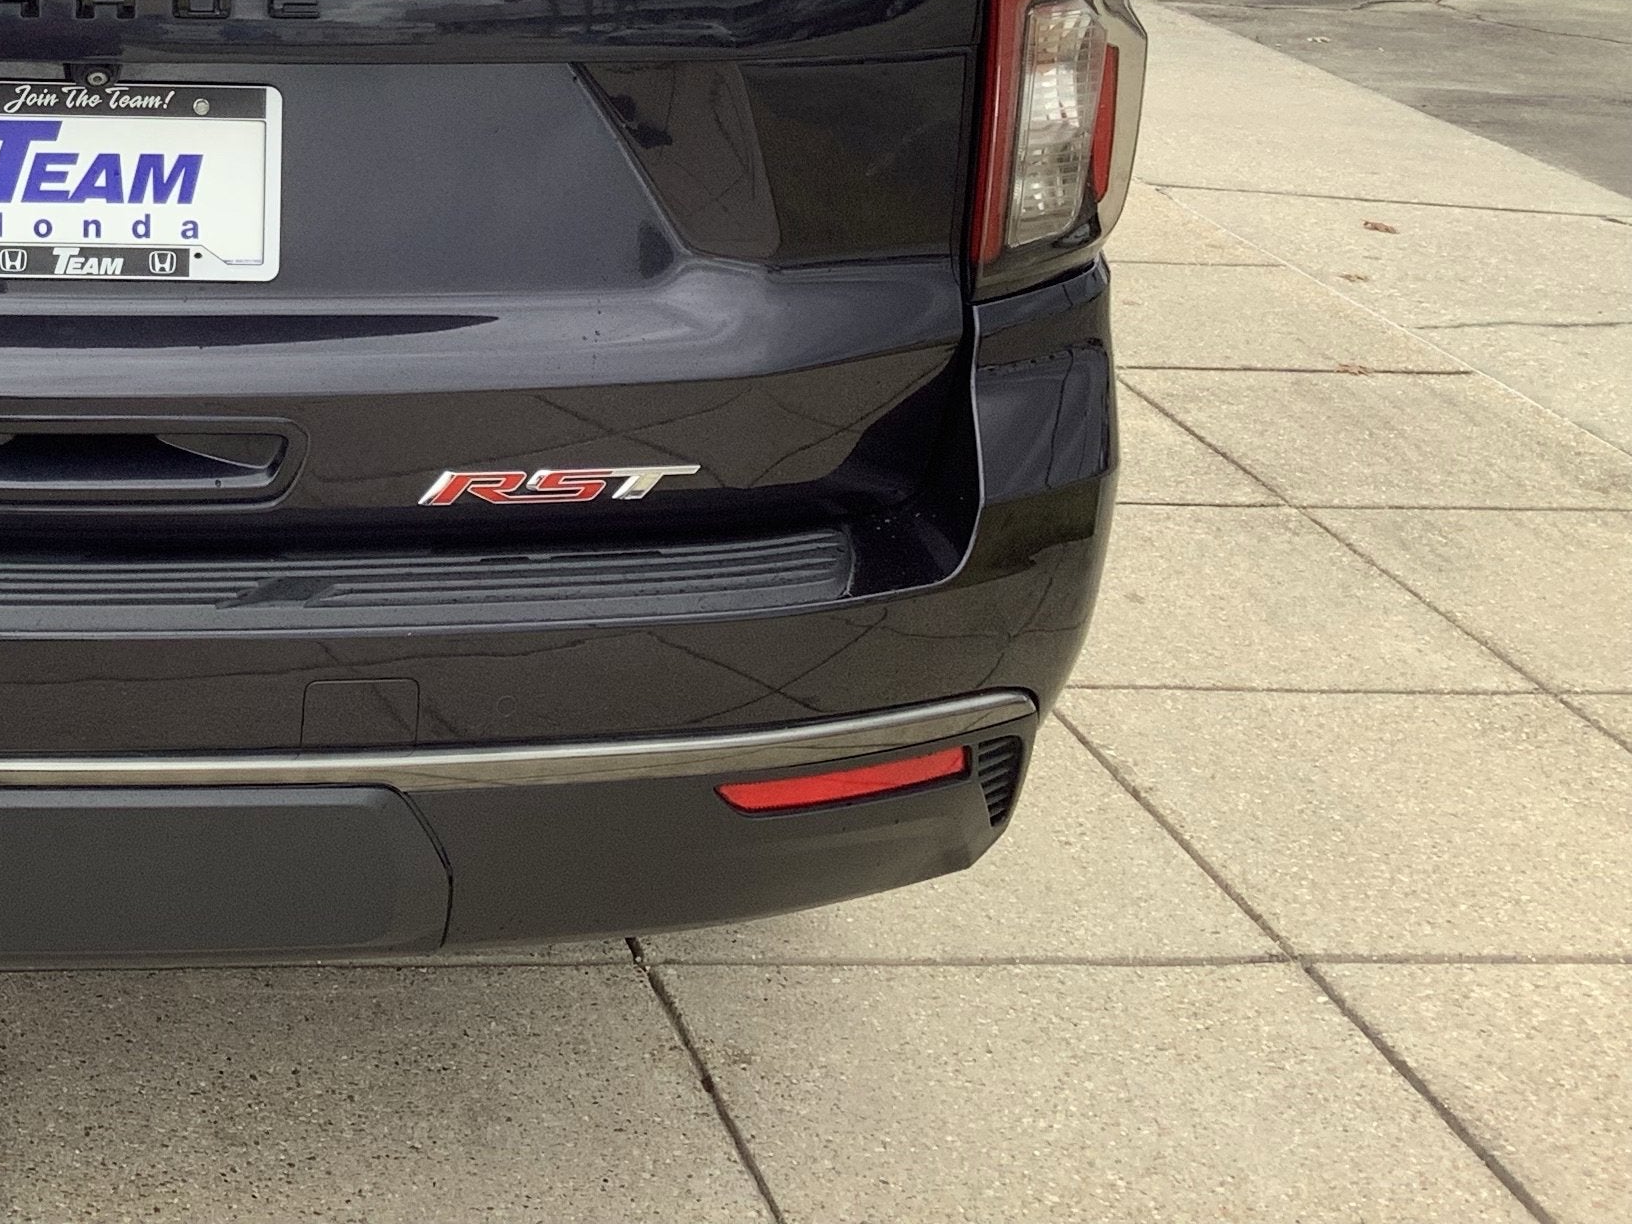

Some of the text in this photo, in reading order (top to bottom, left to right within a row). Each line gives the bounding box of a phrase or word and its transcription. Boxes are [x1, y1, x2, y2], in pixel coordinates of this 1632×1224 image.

[3, 84, 176, 113] Join The Team!
[52, 247, 125, 275] TEAM
[418, 464, 702, 507] RST
